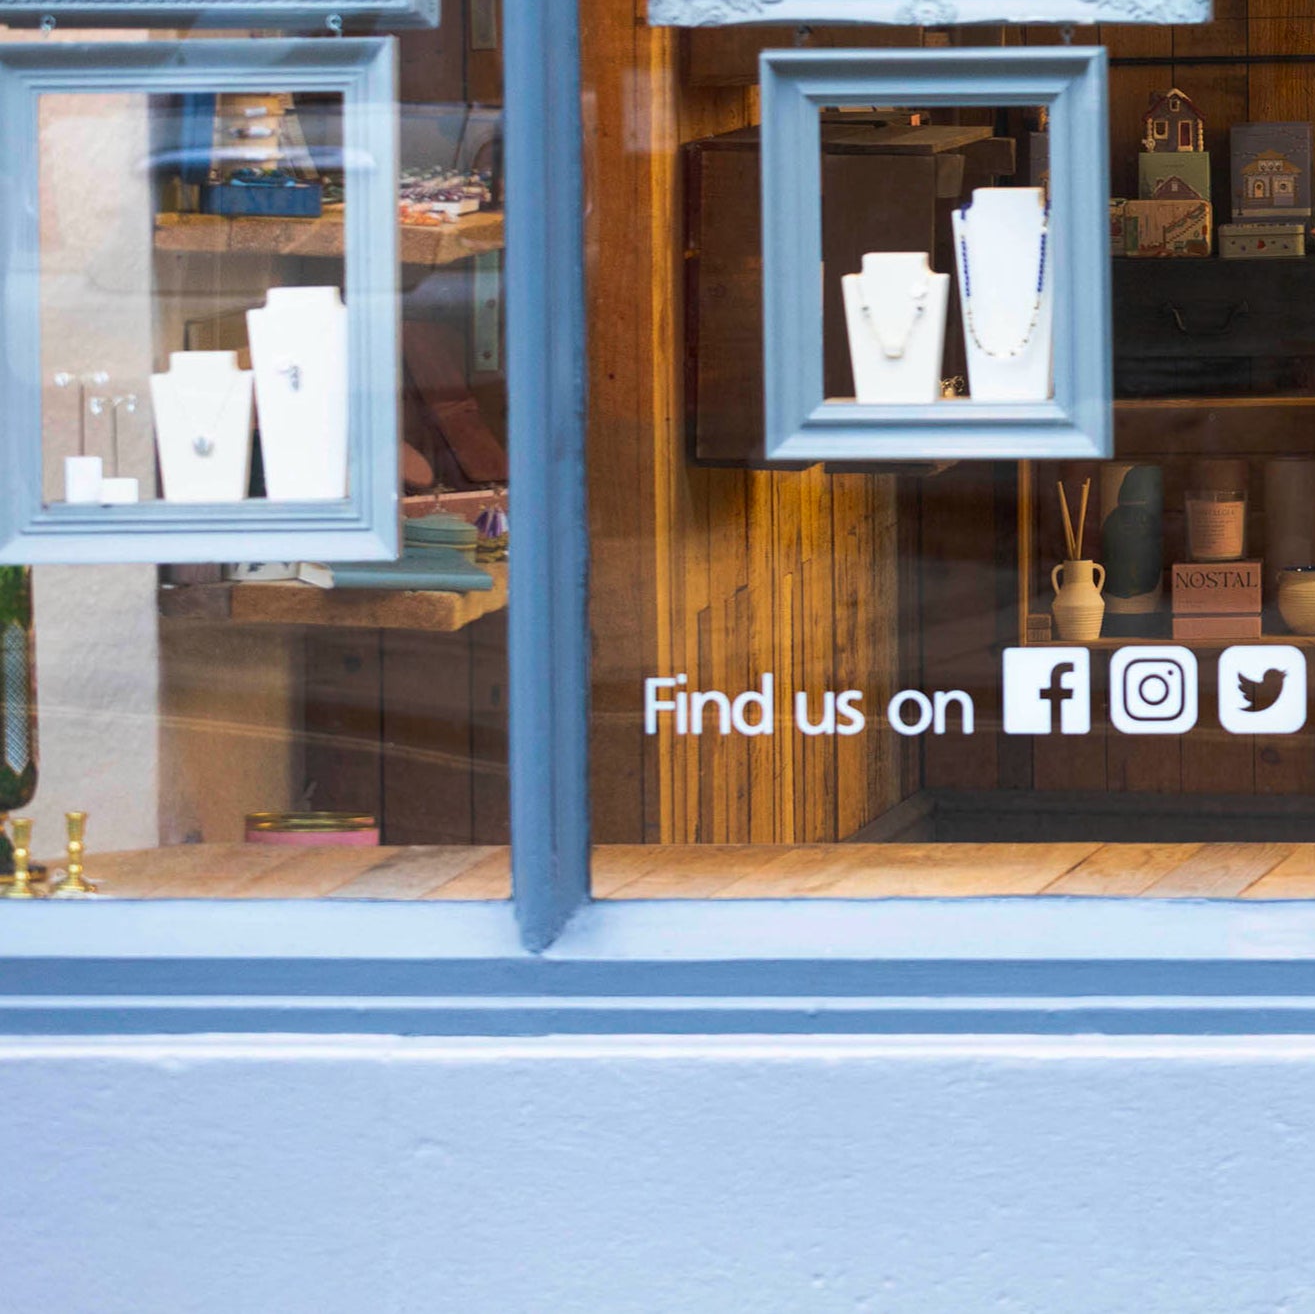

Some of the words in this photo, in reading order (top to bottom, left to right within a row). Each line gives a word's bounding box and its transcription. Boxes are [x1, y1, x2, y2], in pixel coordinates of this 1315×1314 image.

[1175, 571, 1258, 589] NOSTAL
[644, 673, 774, 736] Find
[796, 689, 865, 737] us
[888, 689, 975, 737] on
